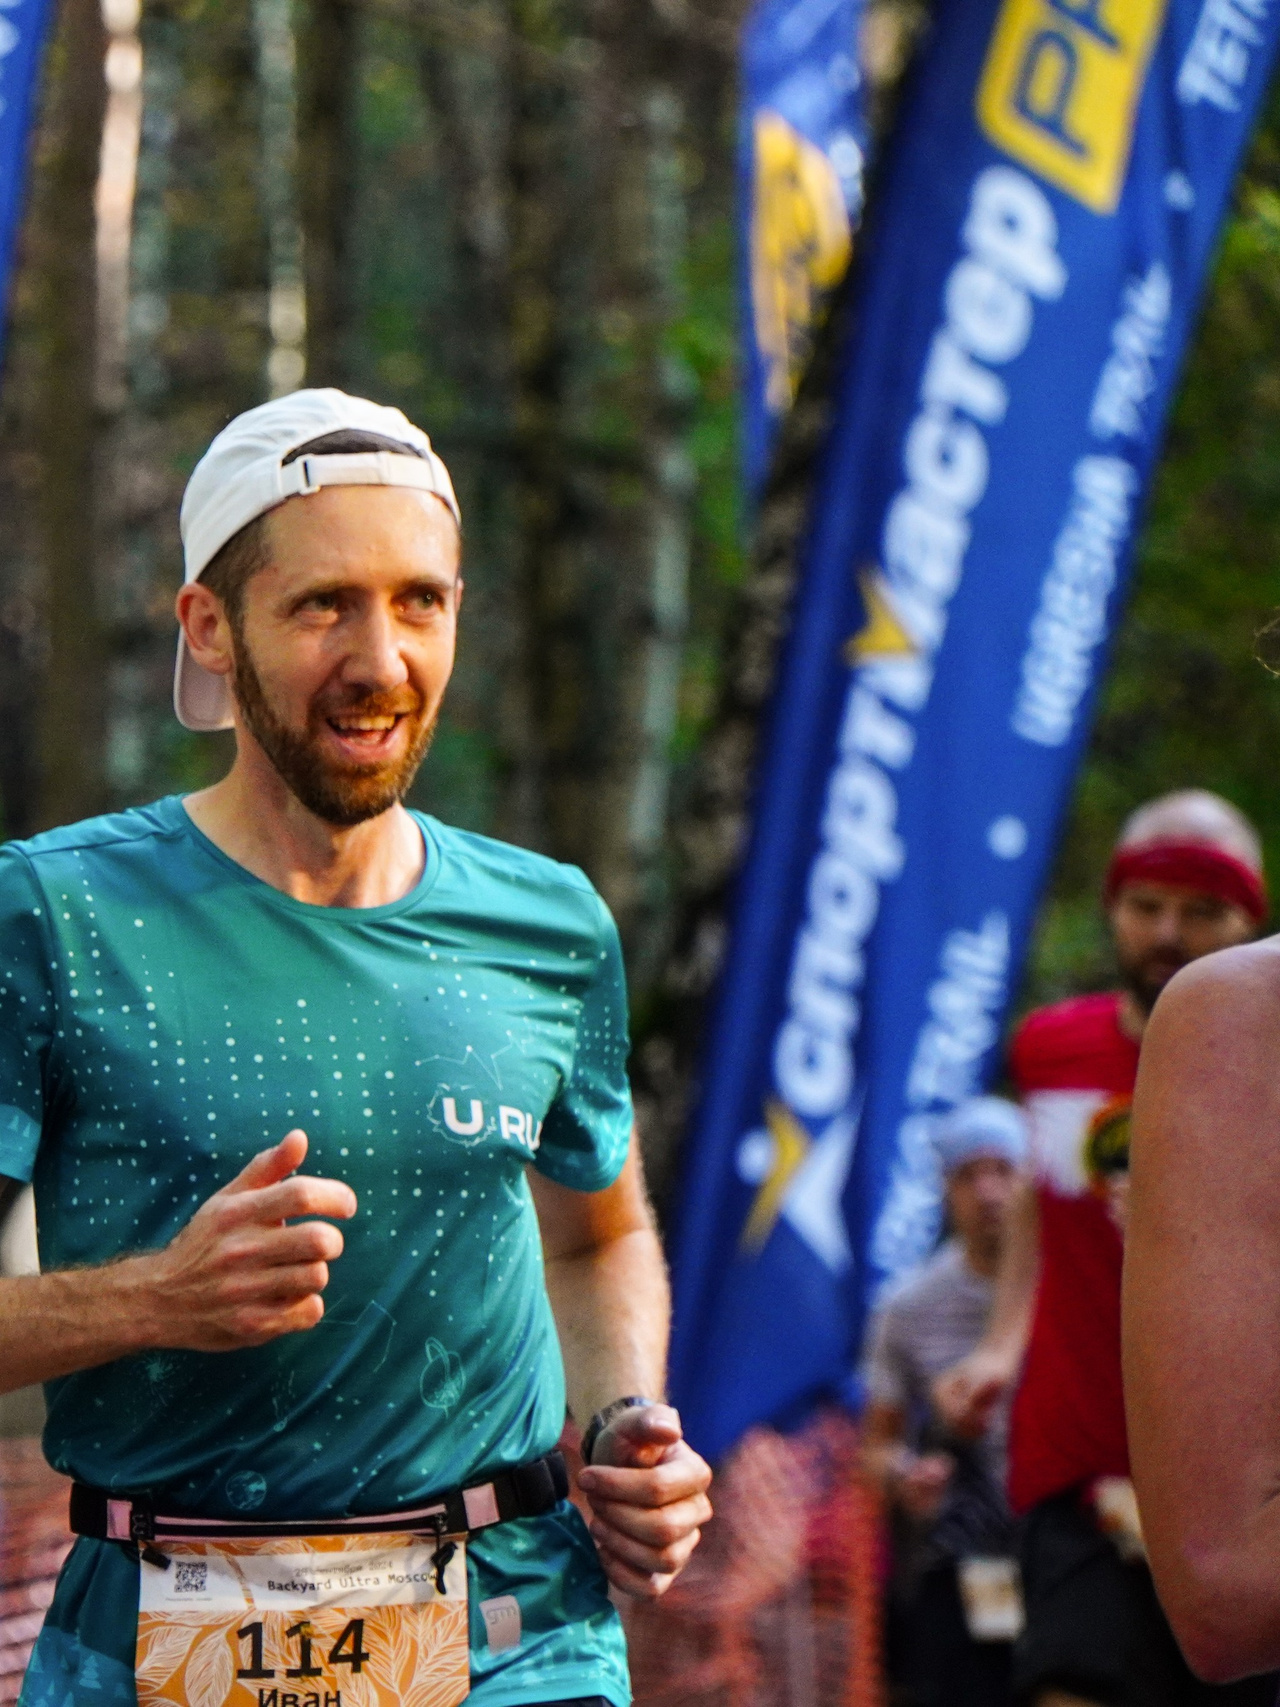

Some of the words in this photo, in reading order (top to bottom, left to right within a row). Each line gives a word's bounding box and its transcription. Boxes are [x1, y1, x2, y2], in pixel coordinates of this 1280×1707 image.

[442, 1097, 484, 1135] U
[267, 1579, 332, 1593] Backyard
[339, 1574, 381, 1588] Ultra
[236, 1618, 370, 1679] 114
[258, 1687, 341, 1707] Иван
